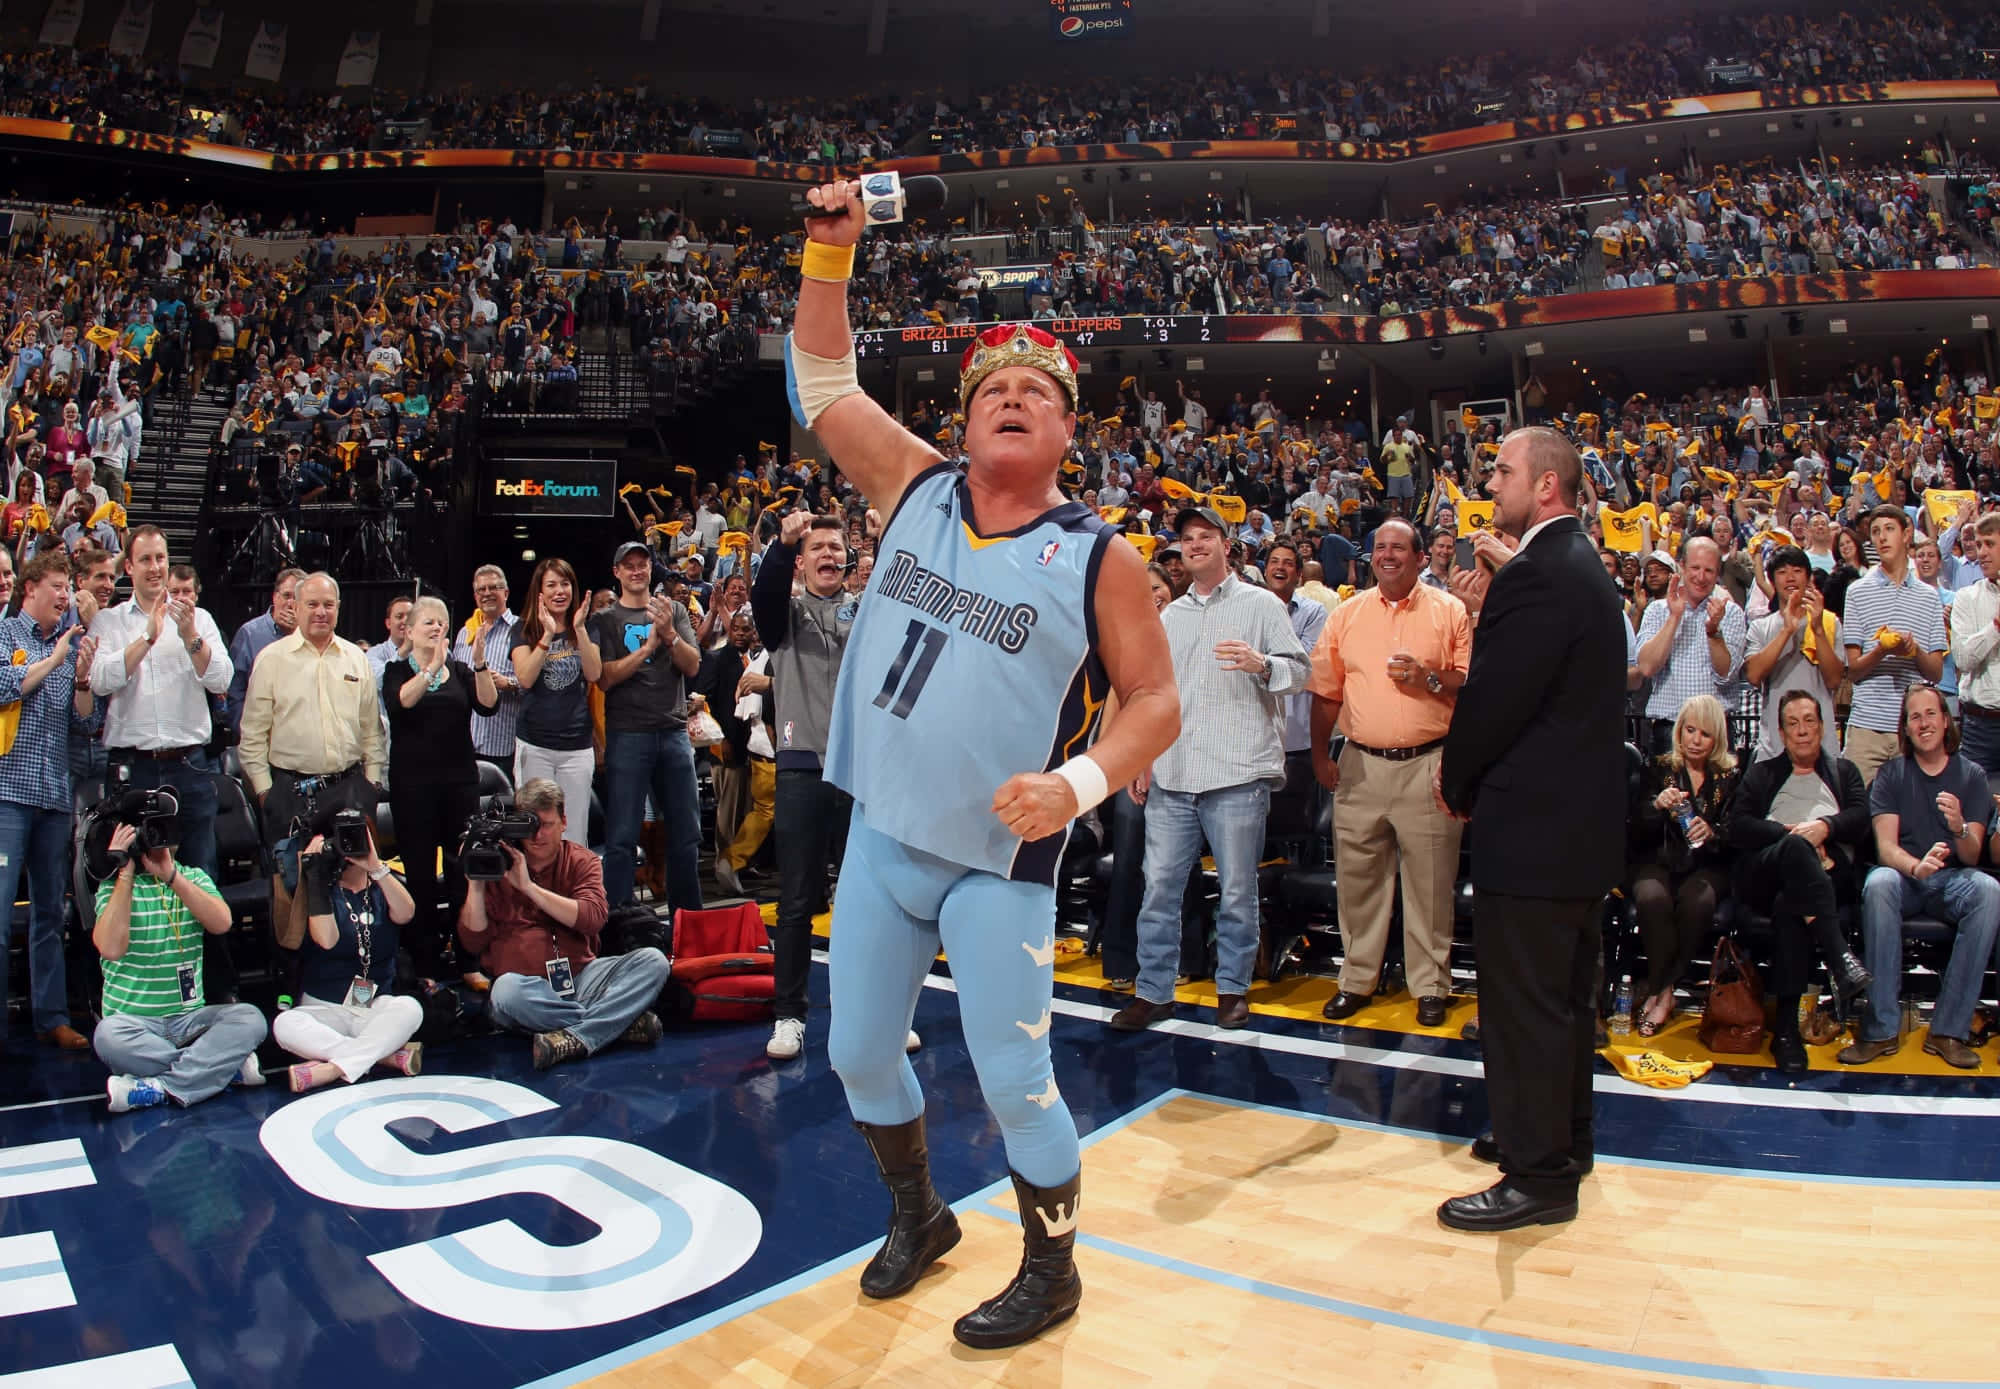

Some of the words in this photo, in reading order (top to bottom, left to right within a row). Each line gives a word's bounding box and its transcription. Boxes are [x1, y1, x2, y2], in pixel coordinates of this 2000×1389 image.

[1086, 17, 1123, 31] pepsi
[1761, 82, 1888, 107] NOISE
[1516, 101, 1672, 137] NOISE
[1674, 272, 1875, 311] NOISE
[902, 325, 977, 342] GRIZZLIES
[1052, 318, 1122, 333] CLIPPERS
[1143, 317, 1177, 328] T.O.L
[1202, 316, 1209, 326] F
[1302, 301, 1538, 343] NOISE
[858, 344, 866, 357] 4
[932, 340, 948, 353] 61
[1076, 332, 1094, 345] 47
[1159, 328, 1169, 342] 3
[1200, 328, 1211, 342] 2
[876, 548, 1039, 655] MEMPHIS
[871, 618, 950, 721] 11
